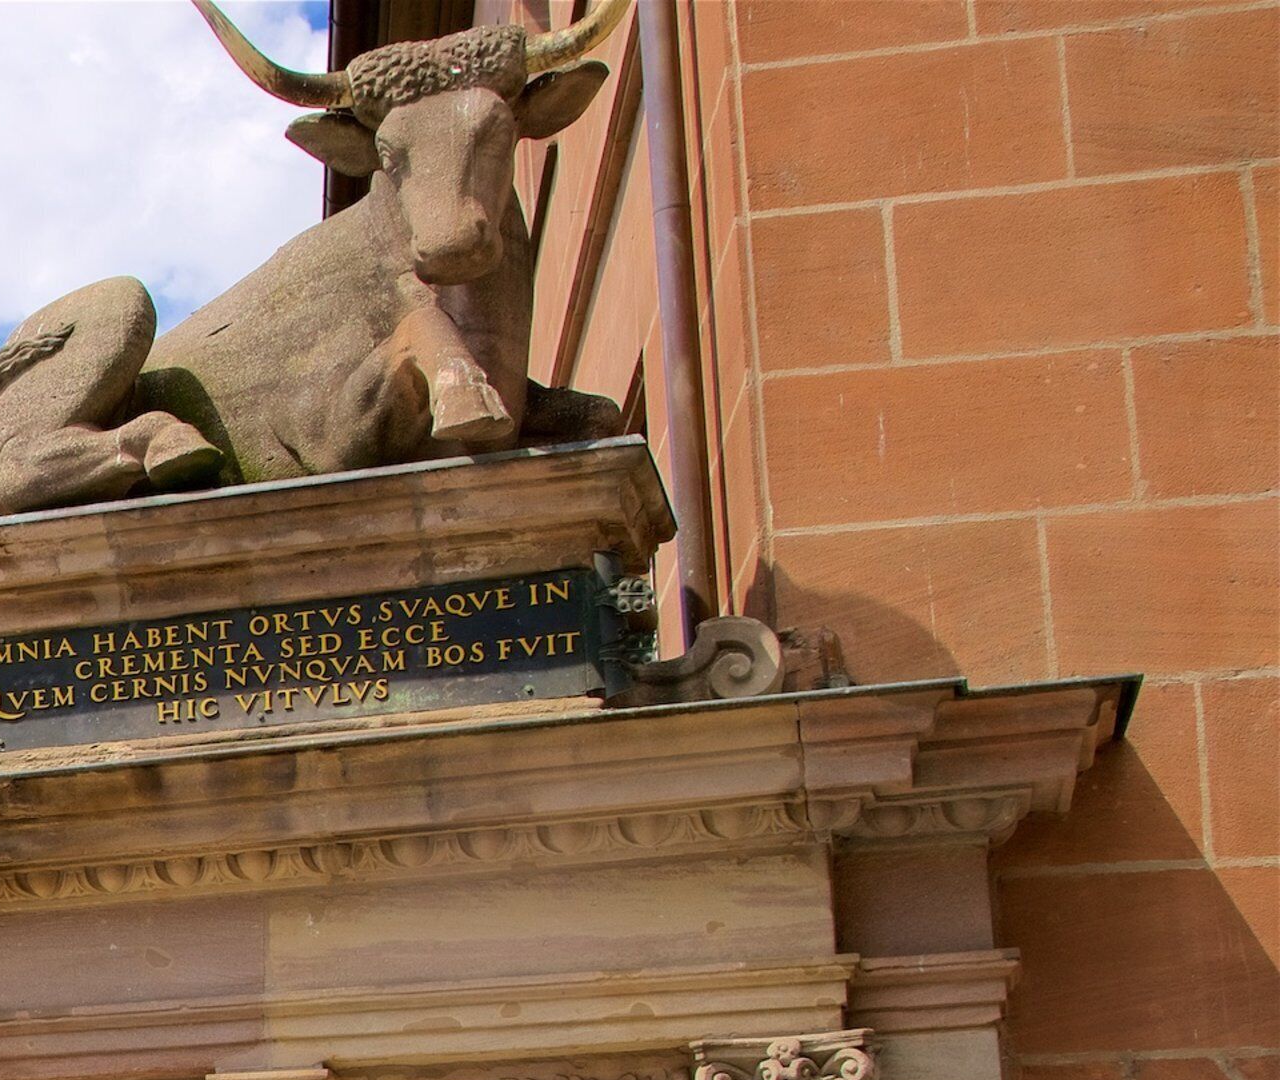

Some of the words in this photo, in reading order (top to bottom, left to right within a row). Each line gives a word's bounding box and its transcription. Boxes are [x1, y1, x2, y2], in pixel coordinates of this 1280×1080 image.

[93, 620, 233, 653] HABENT
[250, 606, 360, 634] ORTVS
[379, 588, 515, 621] SVAQVE
[529, 580, 570, 606] IN
[76, 644, 262, 678] CREMENTA
[282, 635, 341, 656] SED
[358, 621, 449, 650] ECCE
[92, 675, 206, 701] CERNIS
[226, 651, 403, 685] NVNQVAM
[429, 643, 483, 665] BOS
[496, 631, 580, 660] FVIT
[158, 698, 216, 721] HIC
[236, 679, 387, 711] VITVLVS
